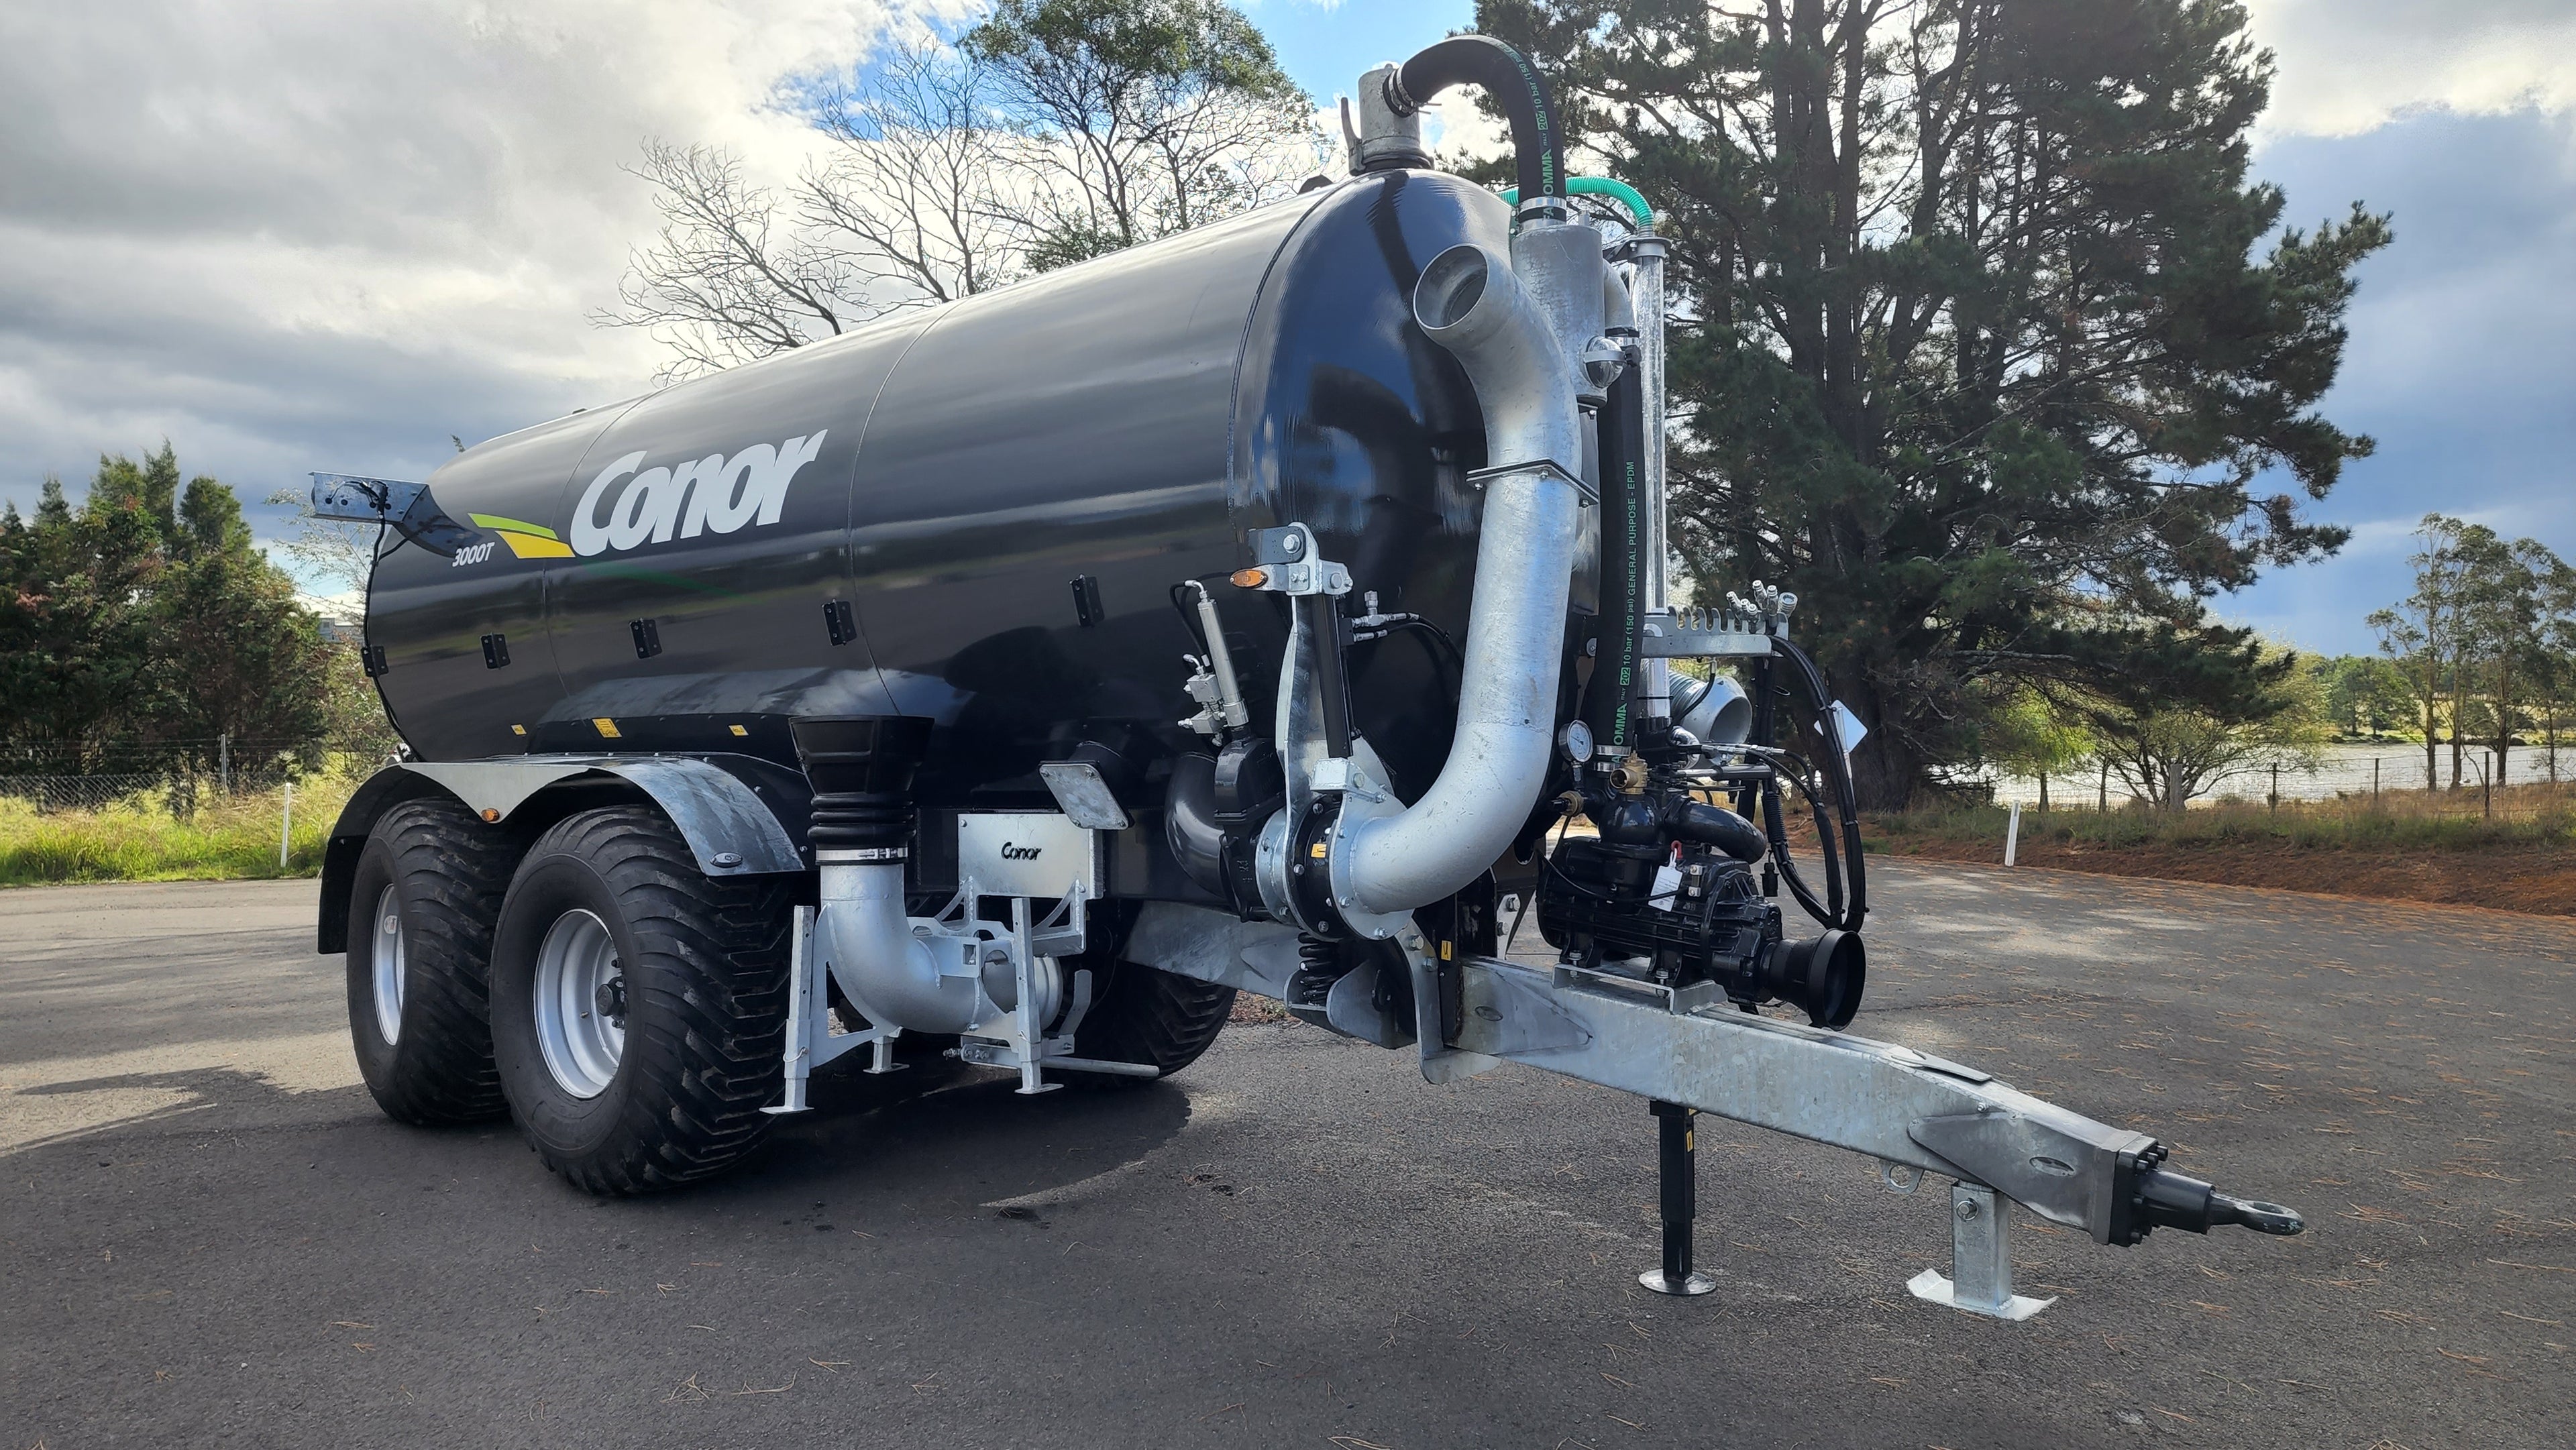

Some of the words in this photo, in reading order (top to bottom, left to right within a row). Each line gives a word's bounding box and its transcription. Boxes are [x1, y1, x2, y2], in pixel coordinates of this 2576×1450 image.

[1519, 63, 1533, 80] (150
[1529, 81, 1540, 97] bar
[1534, 99, 1542, 109] 10
[1537, 112, 1548, 129] 202
[1626, 461, 1635, 490] EPDM
[570, 429, 828, 556] Conor
[1628, 498, 1637, 545] PURPOSE
[452, 542, 495, 567] 3000T
[1627, 548, 1636, 596] GENERAL
[1625, 615, 1634, 634] (150
[1624, 636, 1633, 652] bar
[1623, 655, 1631, 665] 10
[1621, 668, 1630, 684] 202
[1001, 841, 1042, 860] Conor
